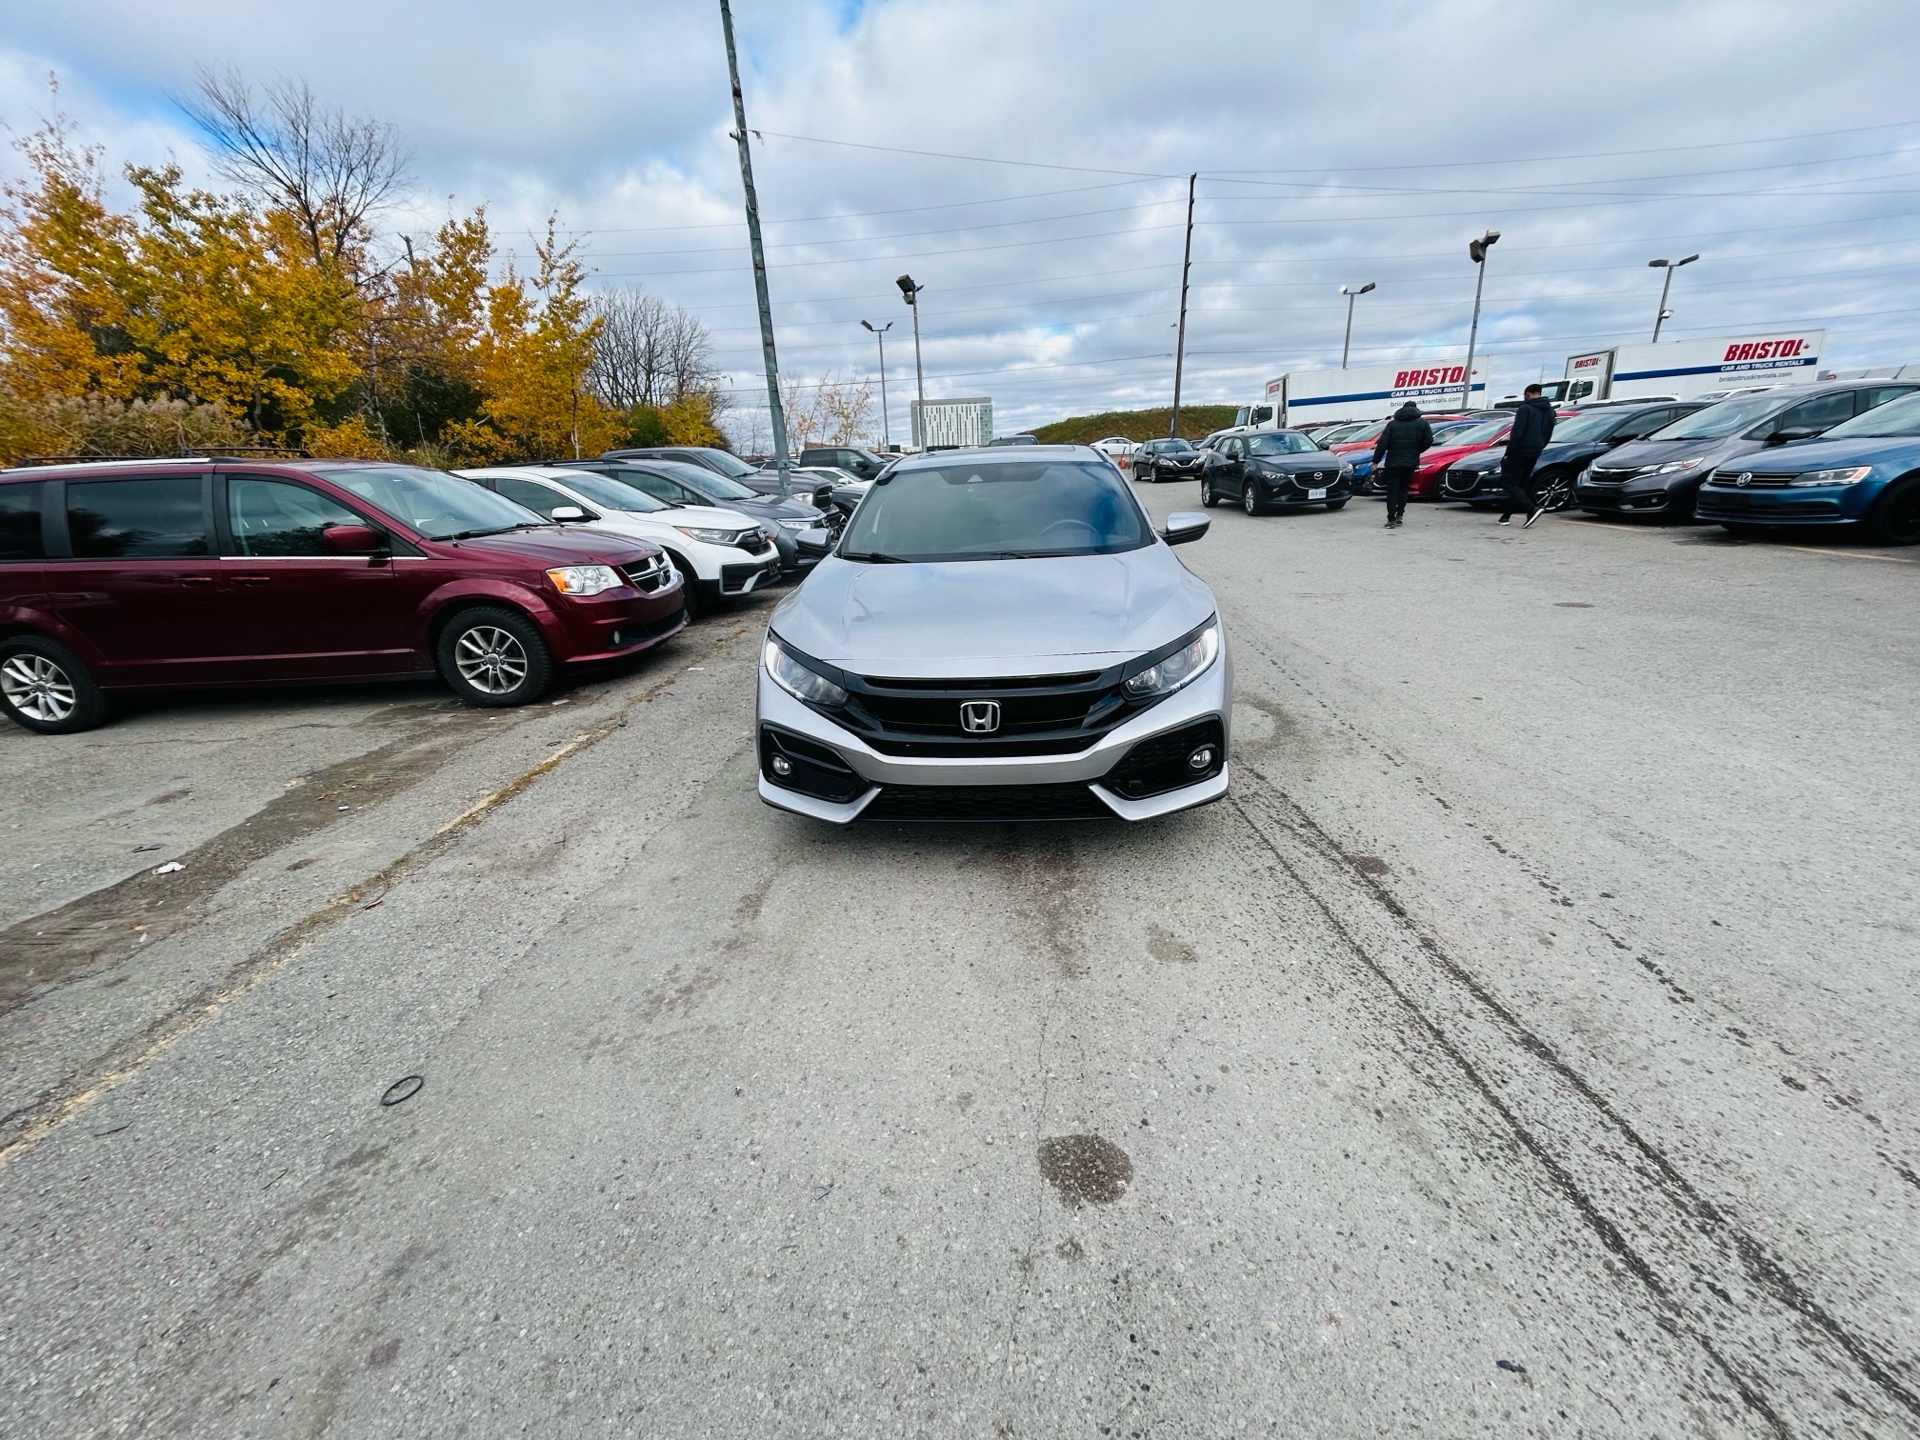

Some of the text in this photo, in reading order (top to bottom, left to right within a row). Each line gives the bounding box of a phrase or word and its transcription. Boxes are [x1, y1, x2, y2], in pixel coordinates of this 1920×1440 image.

[1723, 339, 1804, 361] BRISTOL
[1751, 362, 1773, 370] TRUCK
[1774, 360, 1805, 368] RENTALS
[1391, 390, 1405, 398] CAR
[1420, 387, 1442, 395] TRUCK
[1443, 385, 1473, 393] RENTAS
